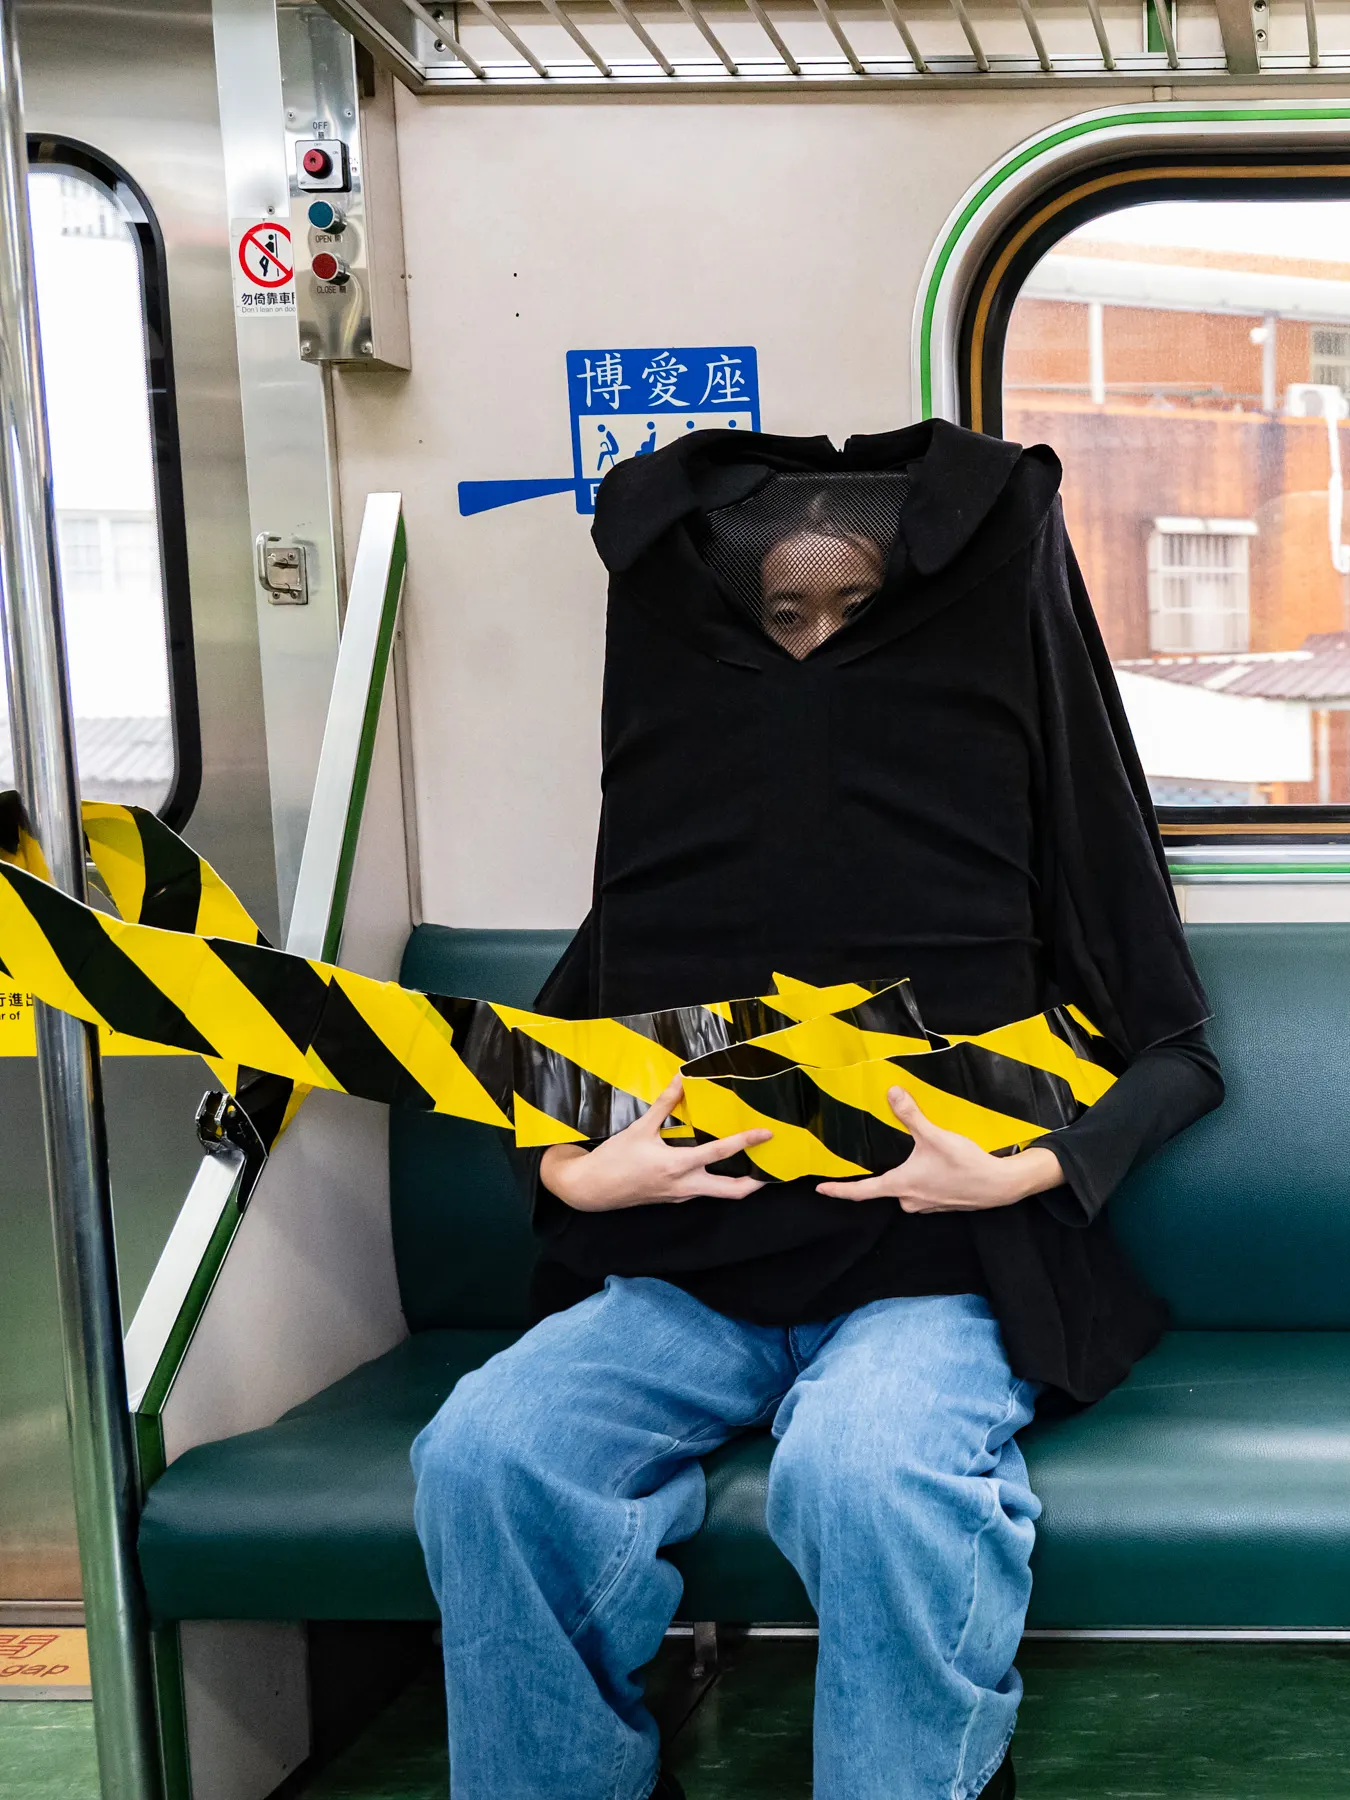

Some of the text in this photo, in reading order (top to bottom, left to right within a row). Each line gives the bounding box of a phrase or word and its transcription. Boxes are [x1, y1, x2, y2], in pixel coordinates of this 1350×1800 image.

[315, 235, 332, 243] OPEN
[316, 286, 336, 294] CLOSE
[576, 351, 751, 410] 博愛座
[9, 1010, 20, 1020] of
[0, 1664, 70, 1678] gap
